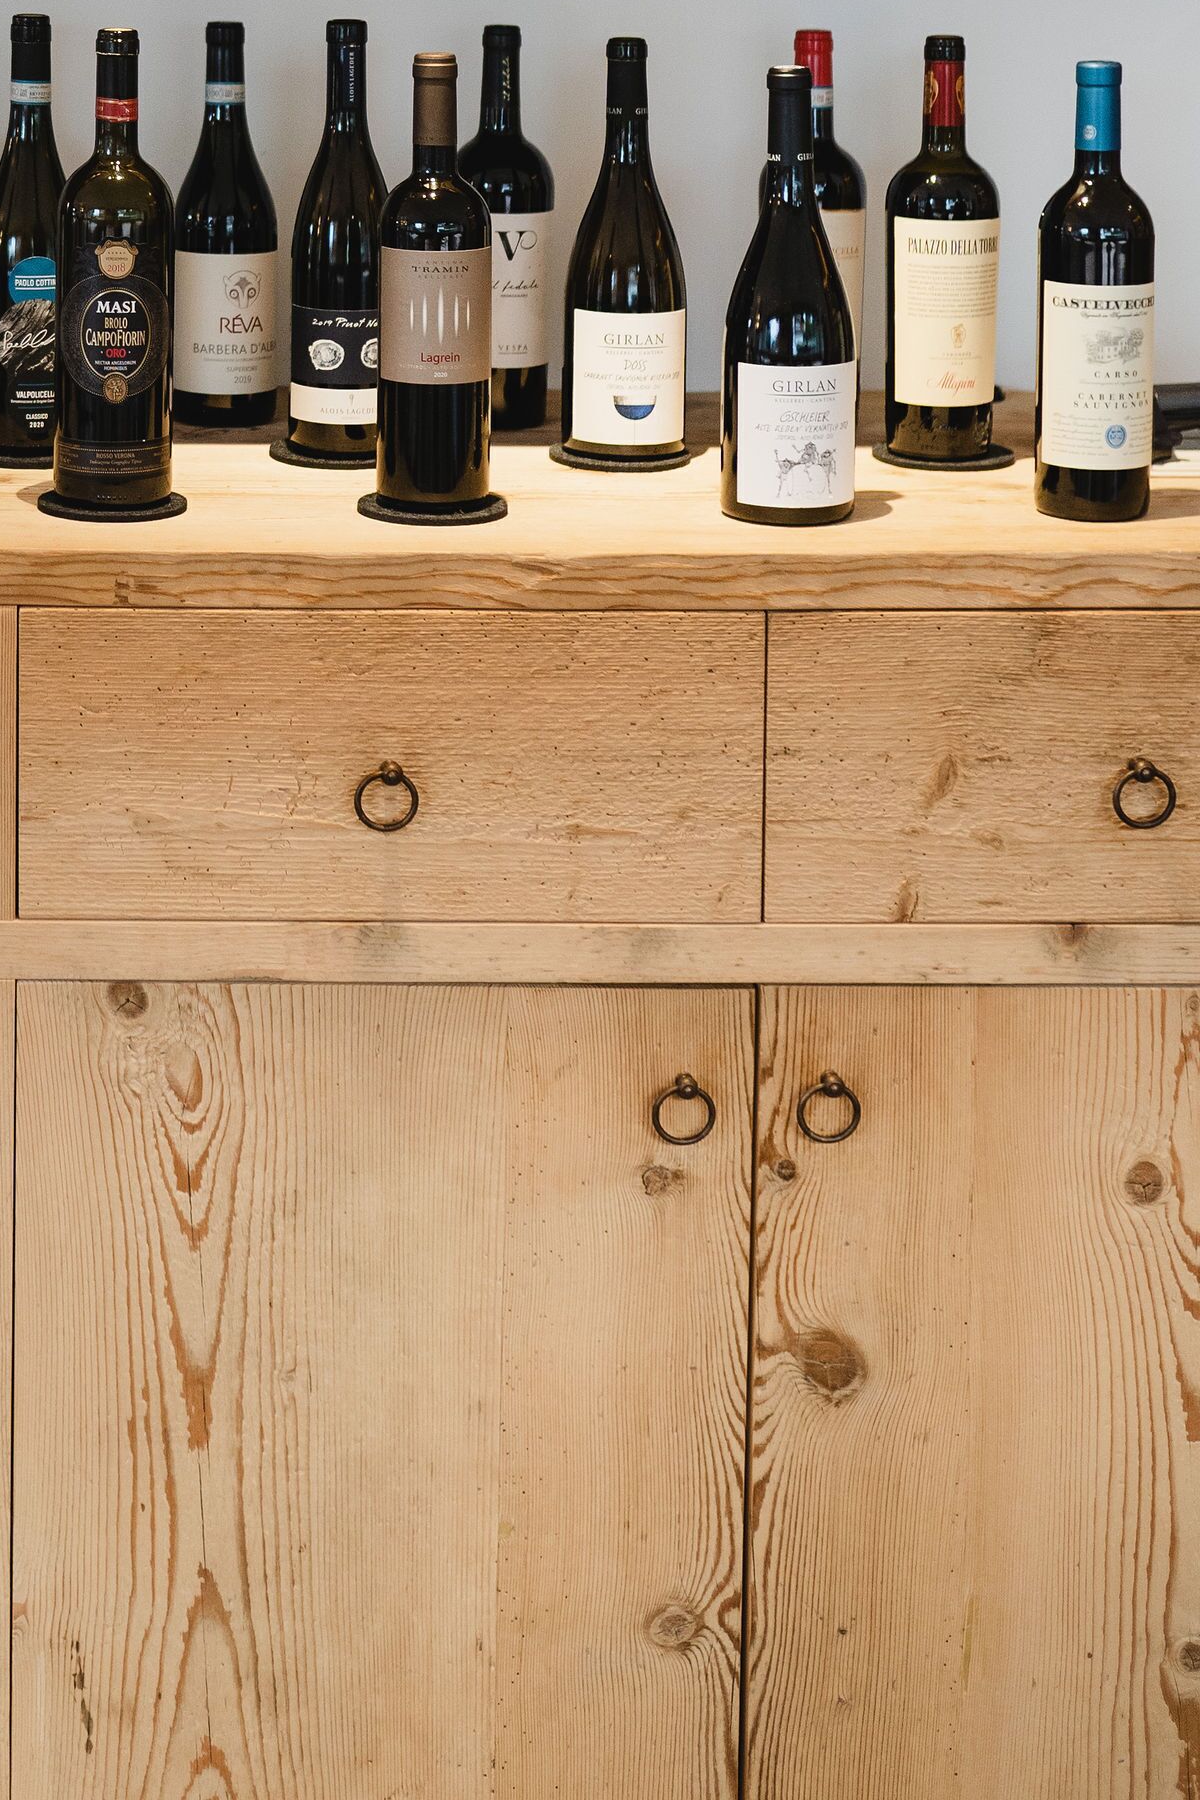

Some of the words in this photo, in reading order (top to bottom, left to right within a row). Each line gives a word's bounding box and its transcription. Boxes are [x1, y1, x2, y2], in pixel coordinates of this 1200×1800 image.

[908, 237, 948, 255] PALAZZO
[950, 239, 978, 255] DELLA
[107, 263, 127, 273] 2018
[411, 265, 469, 273] TRAMIN
[14, 279, 35, 287] PAOLO
[96, 301, 137, 314] MASI
[104, 317, 128, 329] BROLO
[220, 314, 263, 334] RÉVA
[312, 318, 332, 326] 2019
[335, 317, 365, 328] Pinot
[604, 333, 665, 345] GIRLAN
[106, 348, 126, 359] ORO
[193, 343, 247, 355] BARBERA
[420, 351, 460, 365] Lagrein
[624, 359, 647, 371] DOSS
[234, 376, 252, 384] 2019
[1094, 370, 1138, 378] CARSO
[772, 379, 836, 393] GIRLAN
[1078, 391, 1147, 401] CABERNET
[1073, 400, 1149, 409] SAUVIGNON
[780, 411, 830, 423] GSCHLEIER
